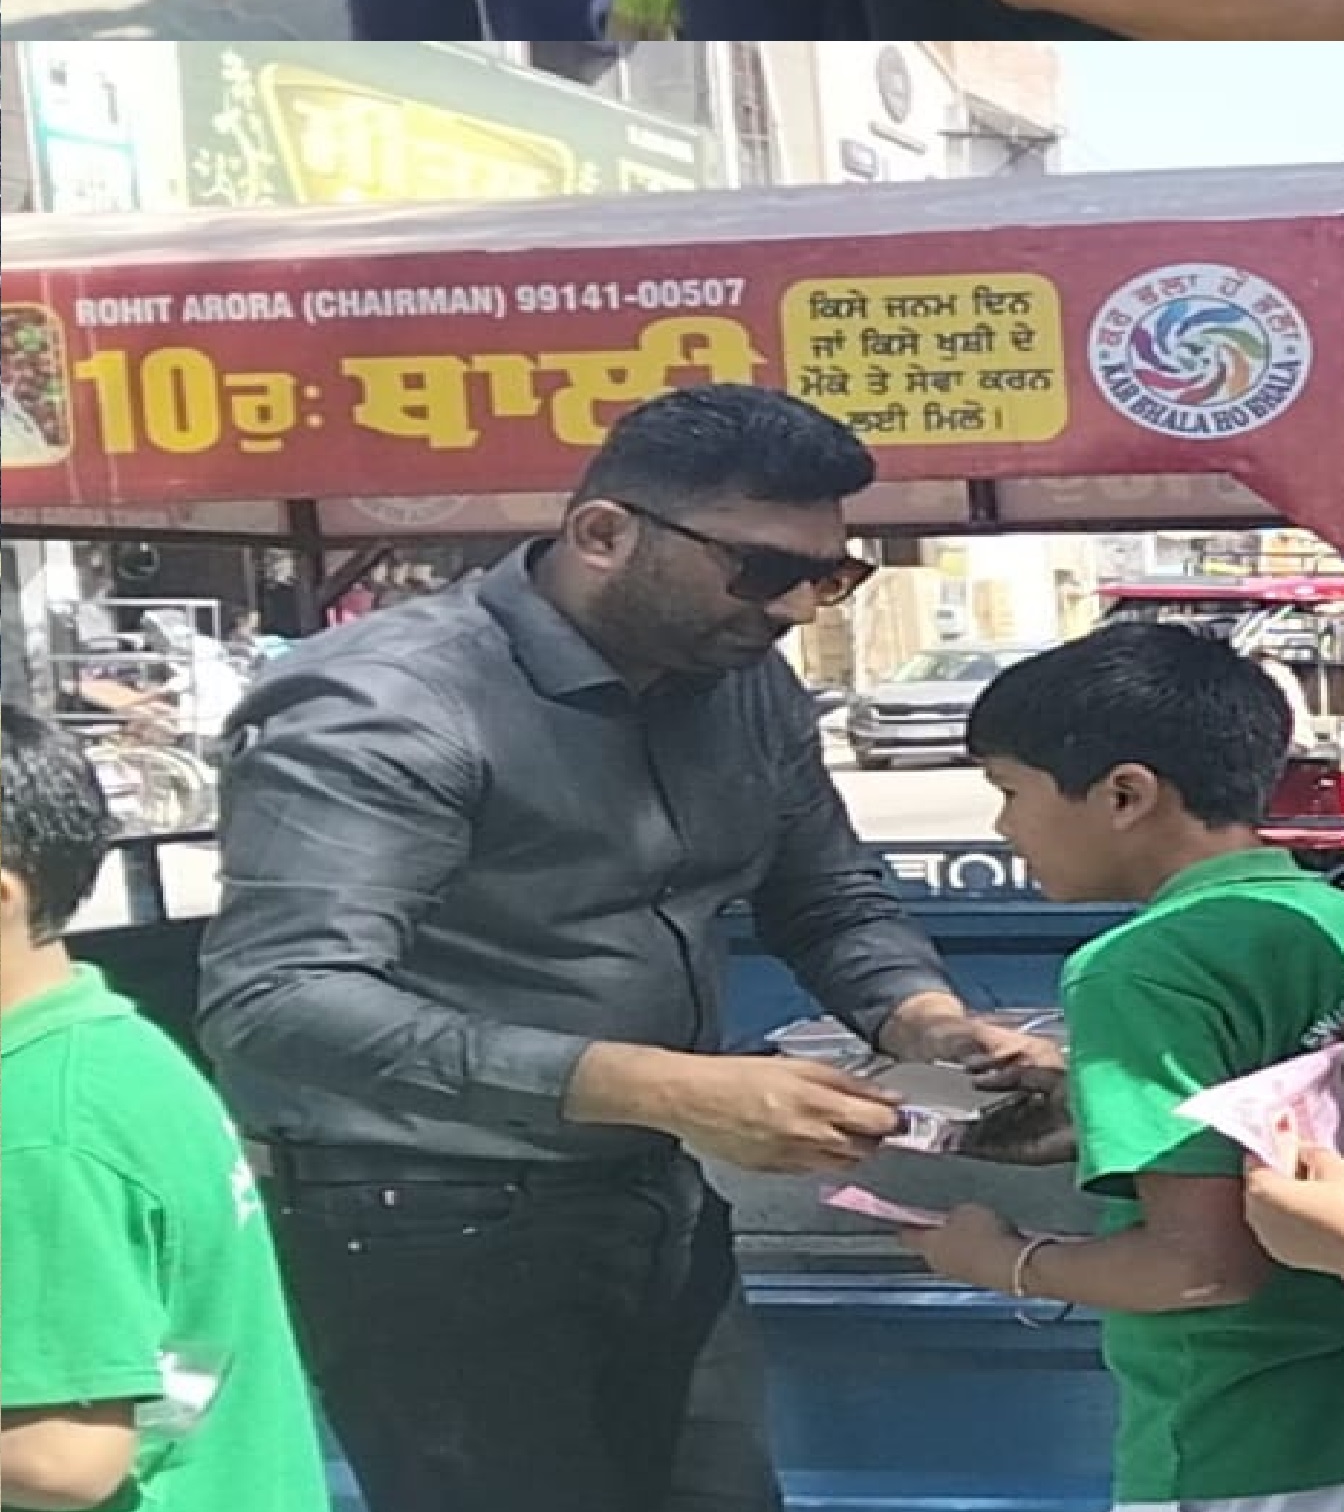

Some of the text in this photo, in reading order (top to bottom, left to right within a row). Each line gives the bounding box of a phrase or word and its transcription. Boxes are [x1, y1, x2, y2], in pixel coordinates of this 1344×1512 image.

[75, 277, 747, 328] ROHIT ARORA (CHAIRMAN) 99141-00507
[1101, 361, 1141, 404] KAR
[1130, 396, 1211, 434] BHALA
